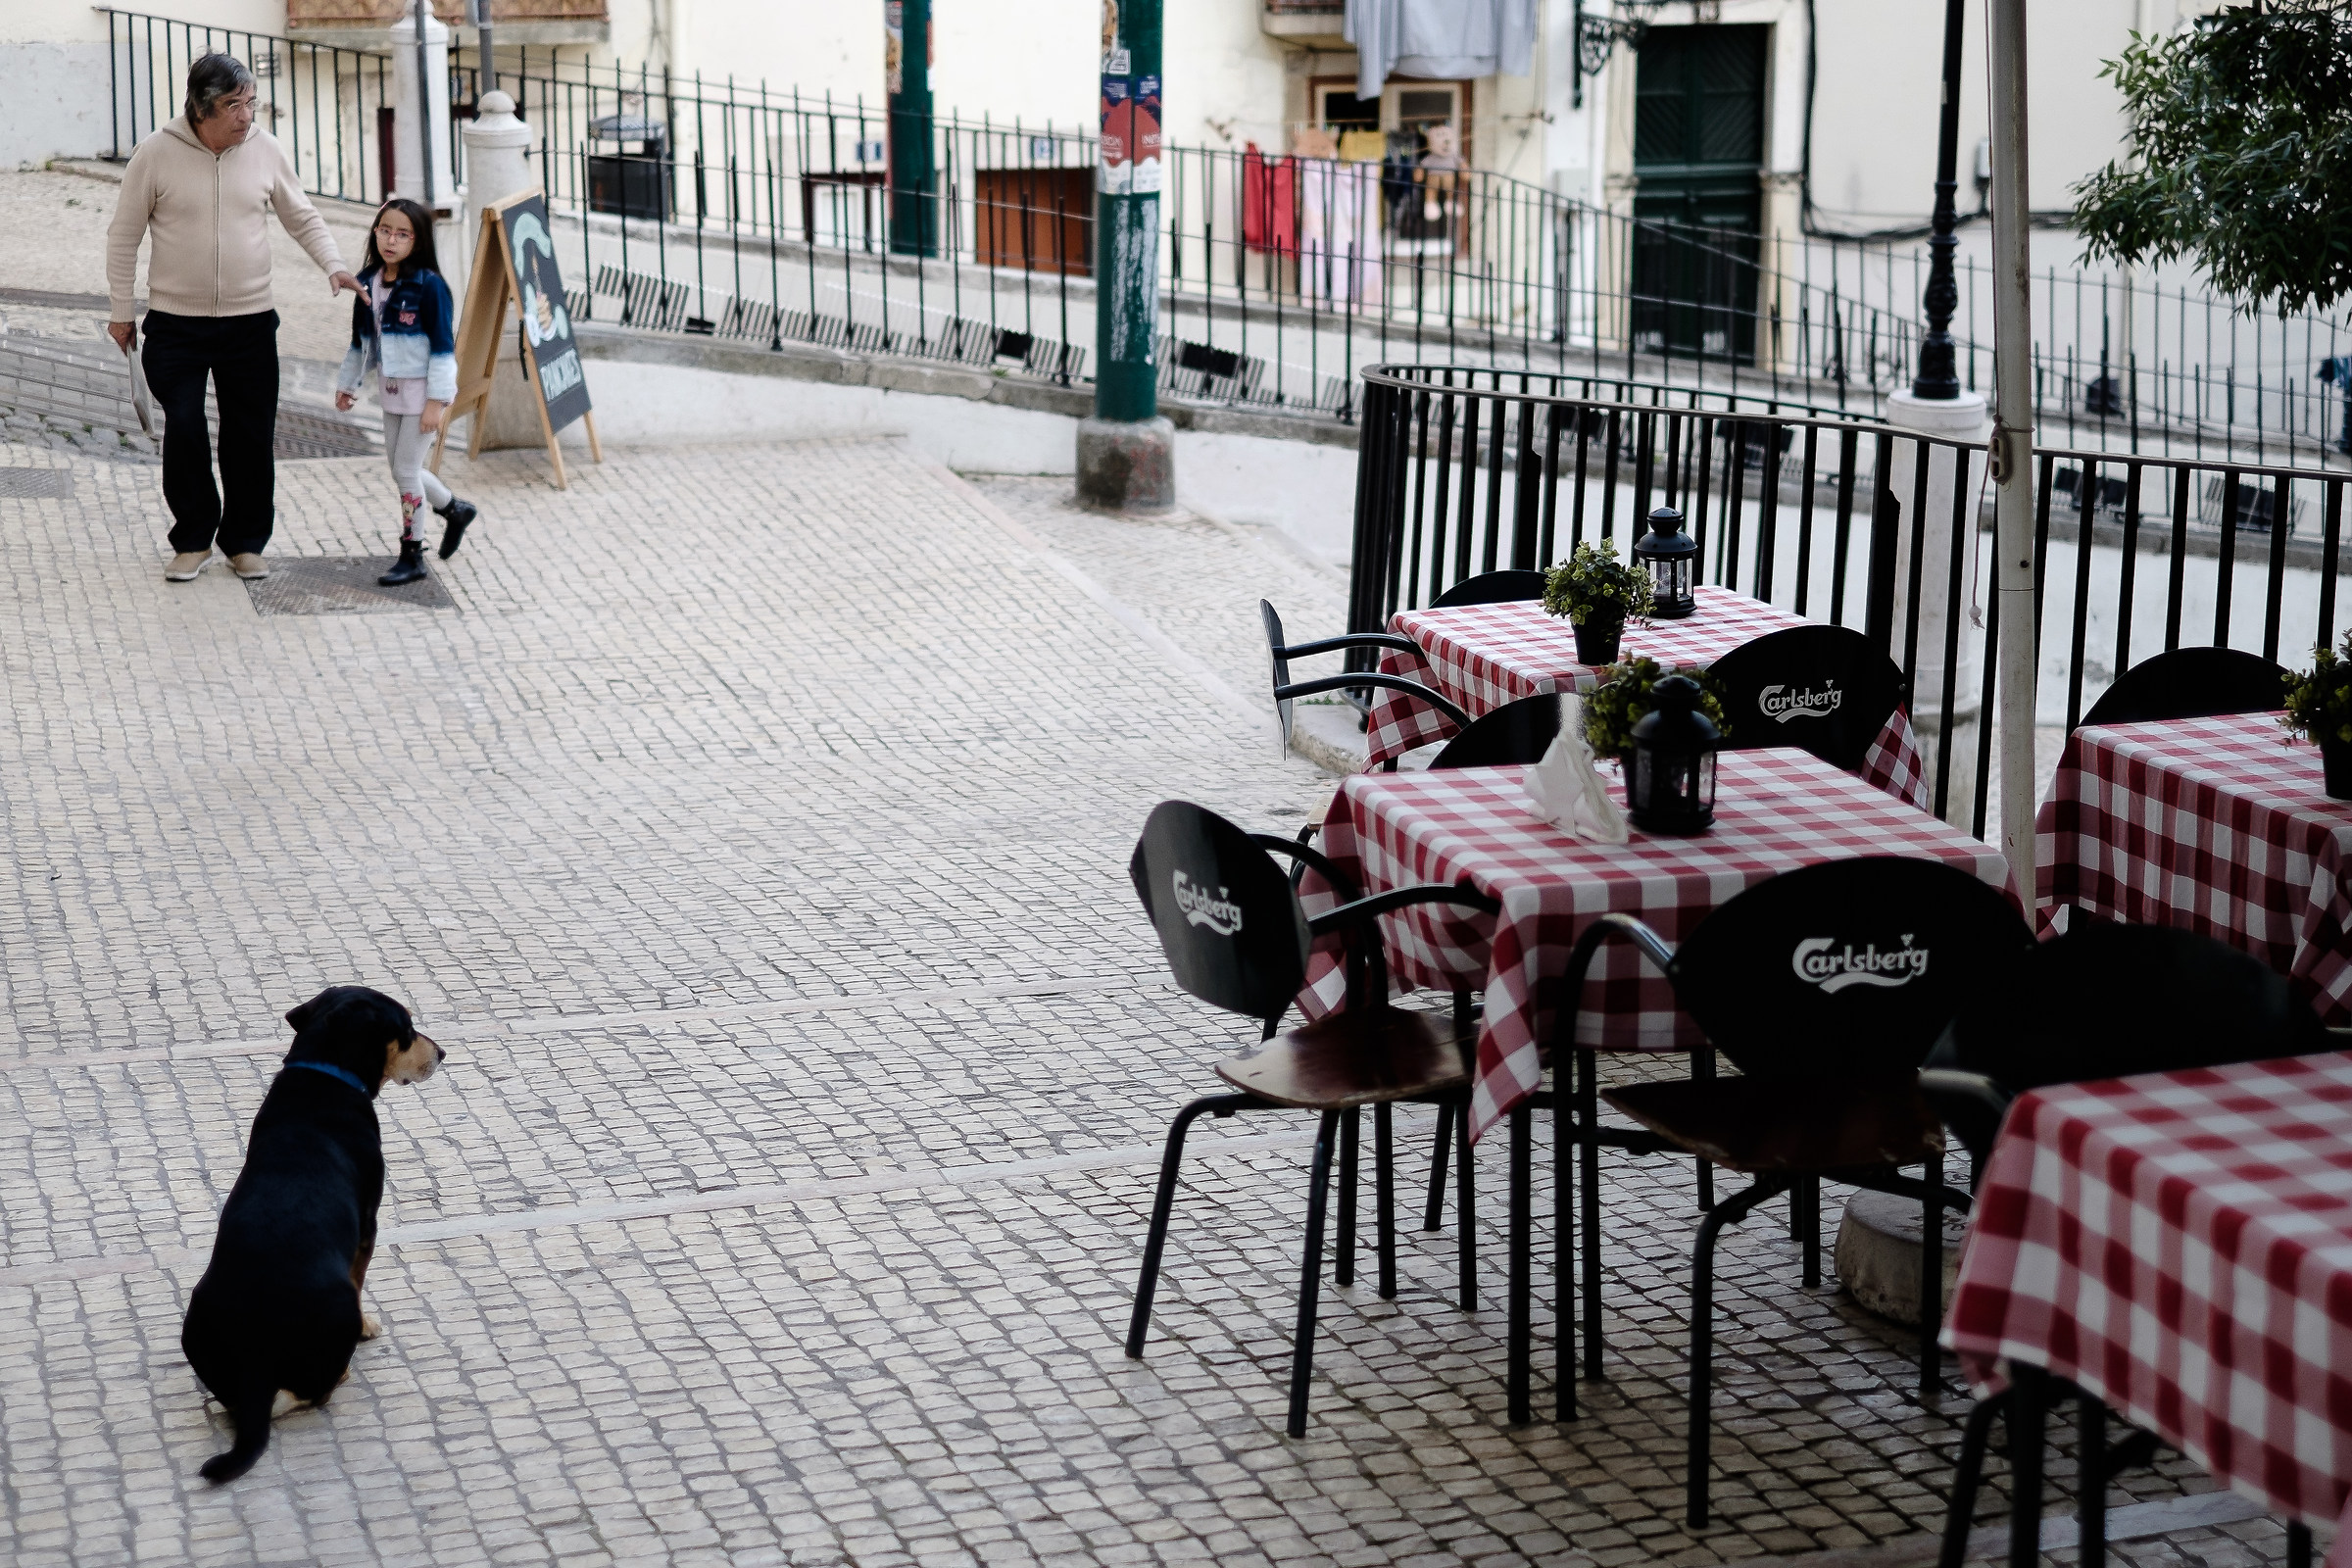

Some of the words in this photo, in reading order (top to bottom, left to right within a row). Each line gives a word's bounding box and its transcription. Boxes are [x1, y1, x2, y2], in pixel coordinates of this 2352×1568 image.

[1758, 683, 1842, 717] Carlsberg
[1173, 869, 1243, 932] Carlsberg
[1792, 937, 1929, 983] Carlsberg
